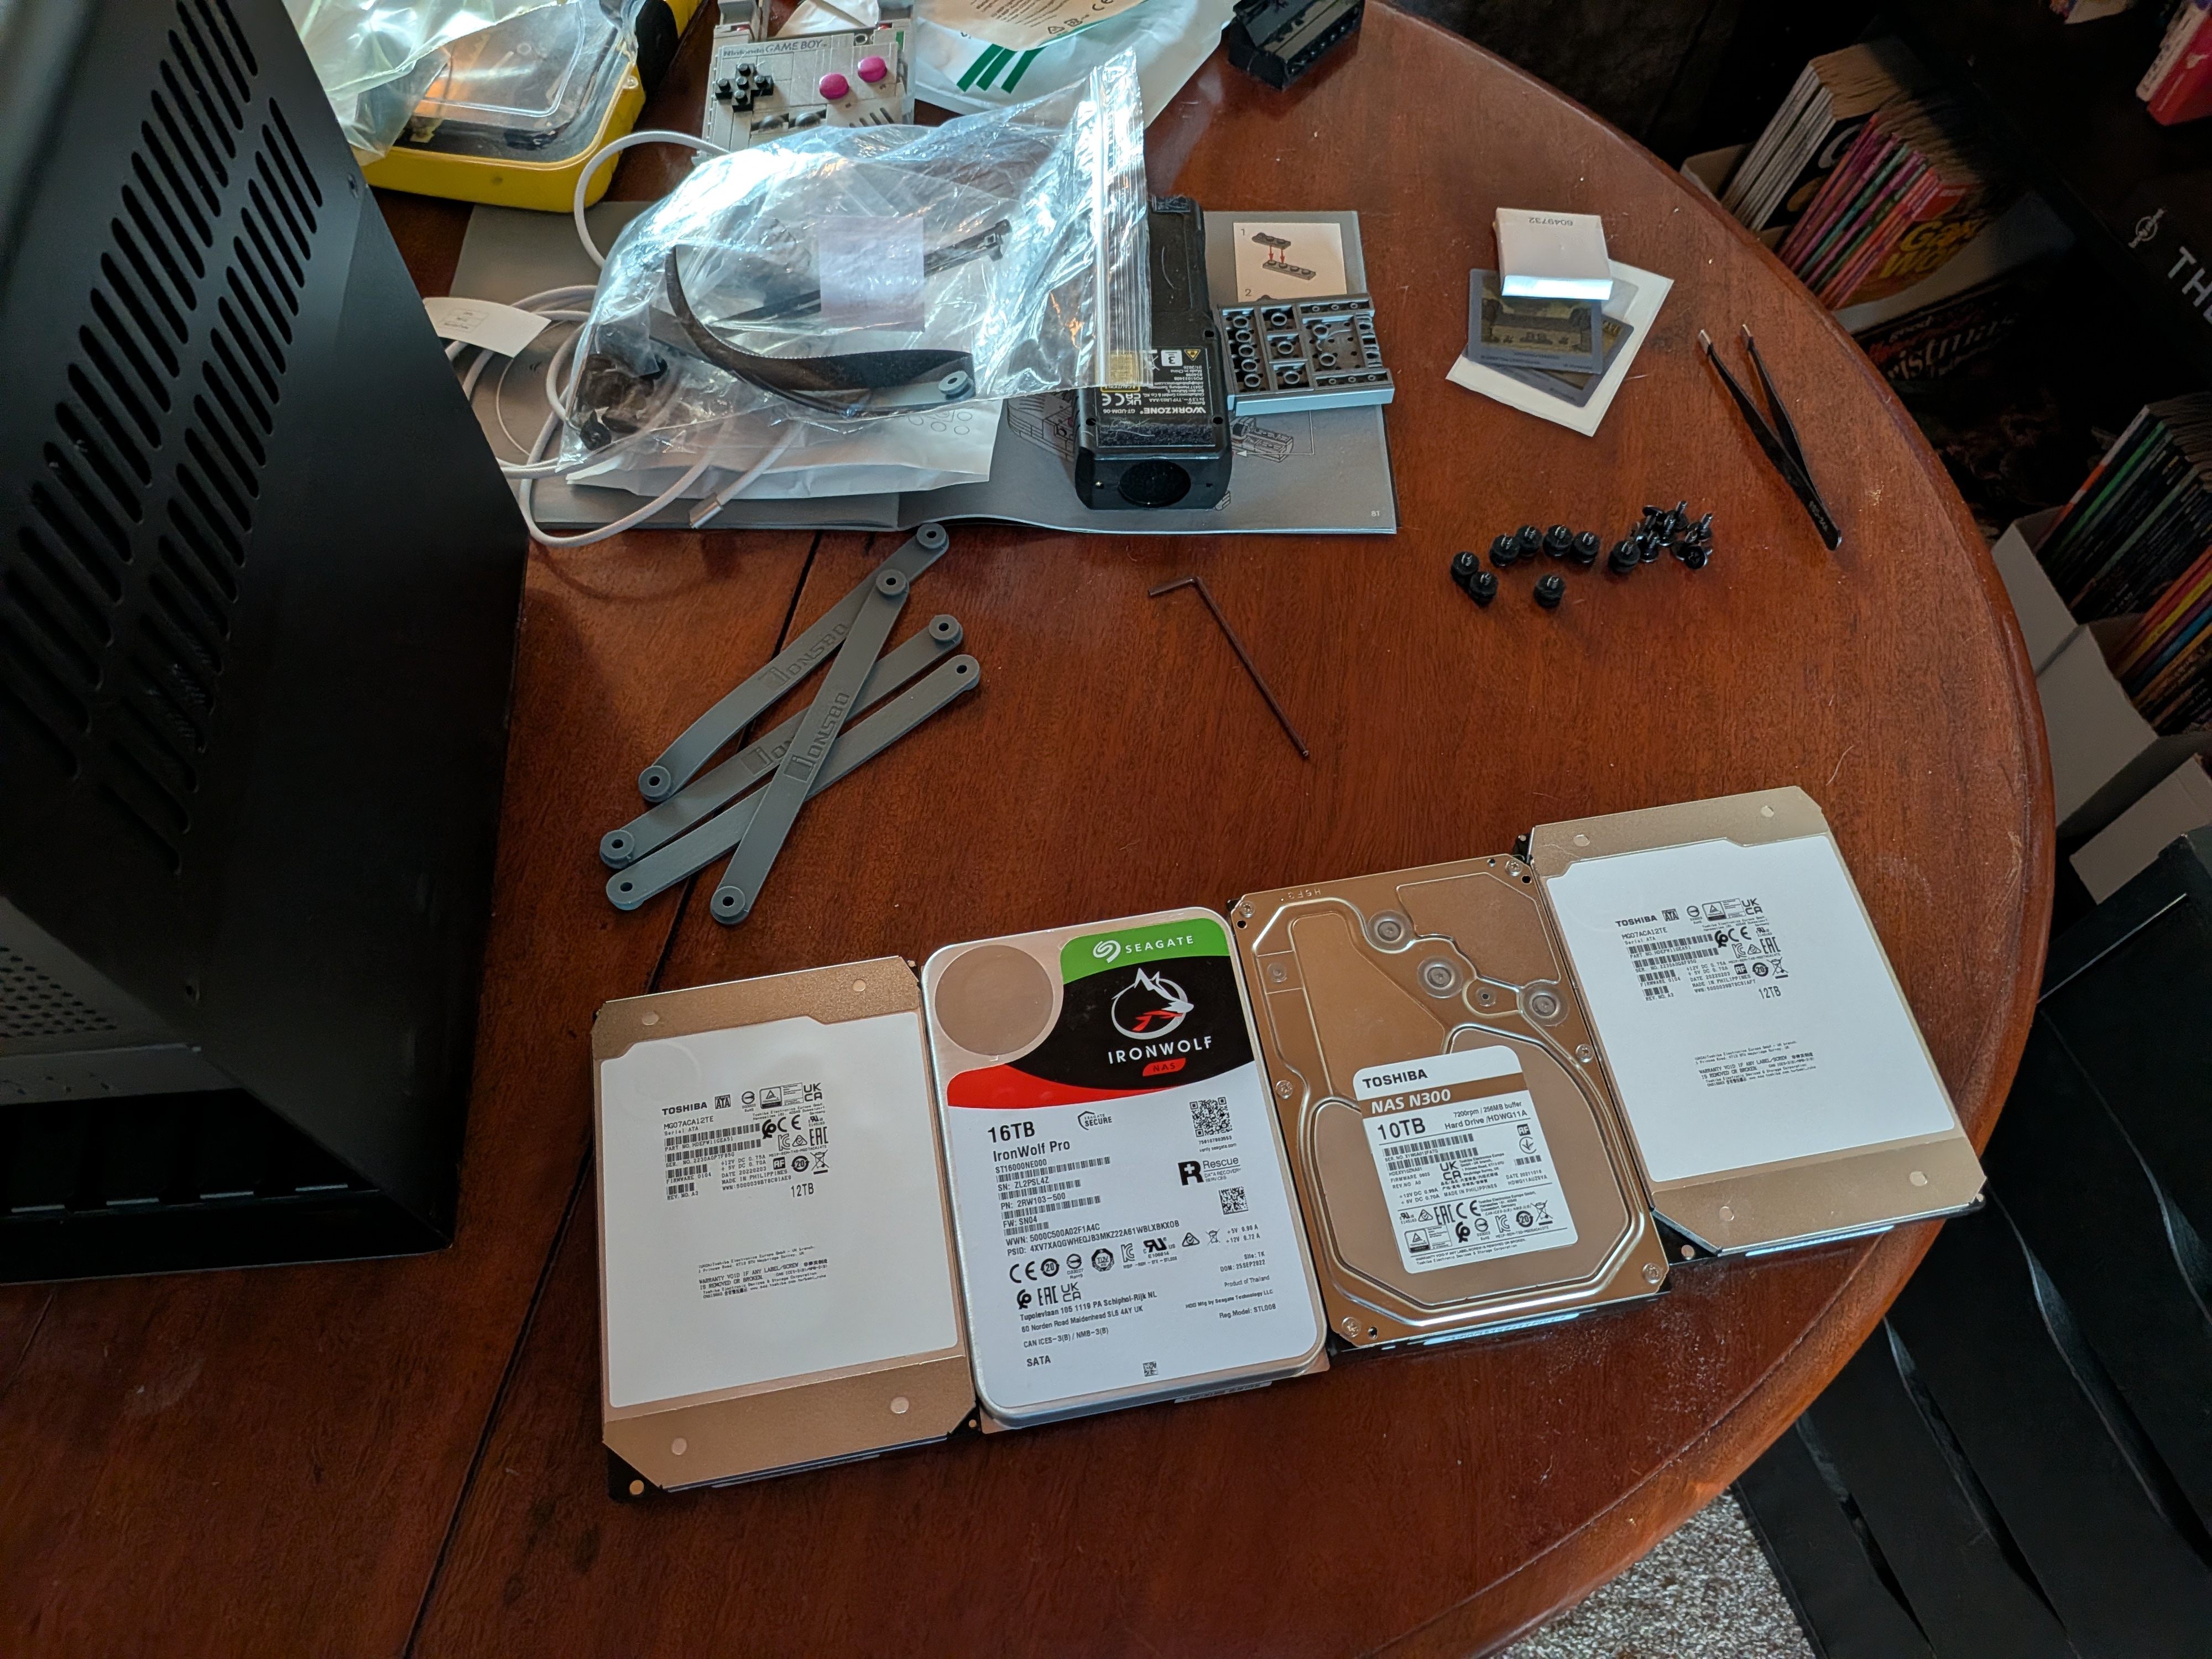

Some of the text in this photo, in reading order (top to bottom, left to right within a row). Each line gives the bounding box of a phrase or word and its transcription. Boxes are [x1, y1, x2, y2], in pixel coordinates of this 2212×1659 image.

[765, 41, 800, 53] GAME
[800, 39, 823, 50] BOY
[1241, 228, 1246, 236] 1
[1244, 289, 1251, 297] 2
[1168, 356, 1176, 364] 3
[1615, 914, 1658, 927] TOSHIBA
[1621, 927, 1668, 940] MG07ACA12TE
[1124, 935, 1195, 956] SEAGATE
[1716, 974, 1751, 984] PHILIPPINES
[1757, 985, 1782, 999] 12TB
[1108, 1035, 1213, 1065] IRONWOLF
[1152, 1062, 1177, 1073] NAS
[1361, 1068, 1428, 1089] TOSHIBA
[1369, 1088, 1453, 1114] NAS N300
[662, 1100, 707, 1116] TOSHIBA
[1453, 1108, 1479, 1119] 7200rpm
[1483, 1103, 1504, 1113] 256MB
[1504, 1100, 1522, 1109] buffer
[663, 1115, 714, 1130] MG07ACA12TE
[1084, 1116, 1112, 1127] SECURE
[1444, 1109, 1528, 1130] Hard Drive /HDWG11A
[664, 1128, 684, 1136] Serial
[987, 1120, 1035, 1144] 16TB
[1376, 1117, 1427, 1140] 10TB
[992, 1138, 1071, 1162] IronWolf Pro
[995, 1159, 1047, 1173] ST16000NE000
[1202, 1155, 1239, 1168] Rescue
[666, 1175, 696, 1185] FIRMWARE
[749, 1167, 787, 1180] PHILIPPINES
[1390, 1174, 1417, 1182] FIRMWARE
[791, 1182, 814, 1198] 12TB
[997, 1176, 1050, 1191] SN: ZL2PSL4Z
[1465, 1183, 1498, 1193] PHILIPPINES
[1000, 1192, 1066, 1210] PN: 2RW103-500
[1002, 1215, 1037, 1227] FW: SN04
[1005, 1223, 1100, 1246] WWN: 5000C500A02F1A4C
[1241, 1225, 1252, 1233] 0.90
[1006, 1246, 1026, 1256] PSID:
[1045, 1262, 1055, 1271] 20
[1235, 1259, 1265, 1269] 25SEP2022
[699, 1275, 724, 1284] WARRANTY
[708, 1280, 731, 1288] REMOVED
[1224, 1279, 1243, 1287] Product
[1249, 1275, 1270, 1283] Thailand
[1060, 1305, 1073, 1314] 105
[1074, 1302, 1091, 1311] 1119
[1103, 1292, 1147, 1308] Schiphol-Rijk
[1214, 1296, 1234, 1304] Seagate
[1235, 1291, 1262, 1300] Technology
[1030, 1321, 1052, 1331] Norden
[1053, 1318, 1069, 1327] Road
[1070, 1312, 1107, 1324] Maidenhead
[1023, 1339, 1037, 1348] CAN
[1038, 1333, 1071, 1346] ICES-3(B)
[1076, 1327, 1109, 1339] NMB-3(B)
[1026, 1355, 1051, 1367] SATA
